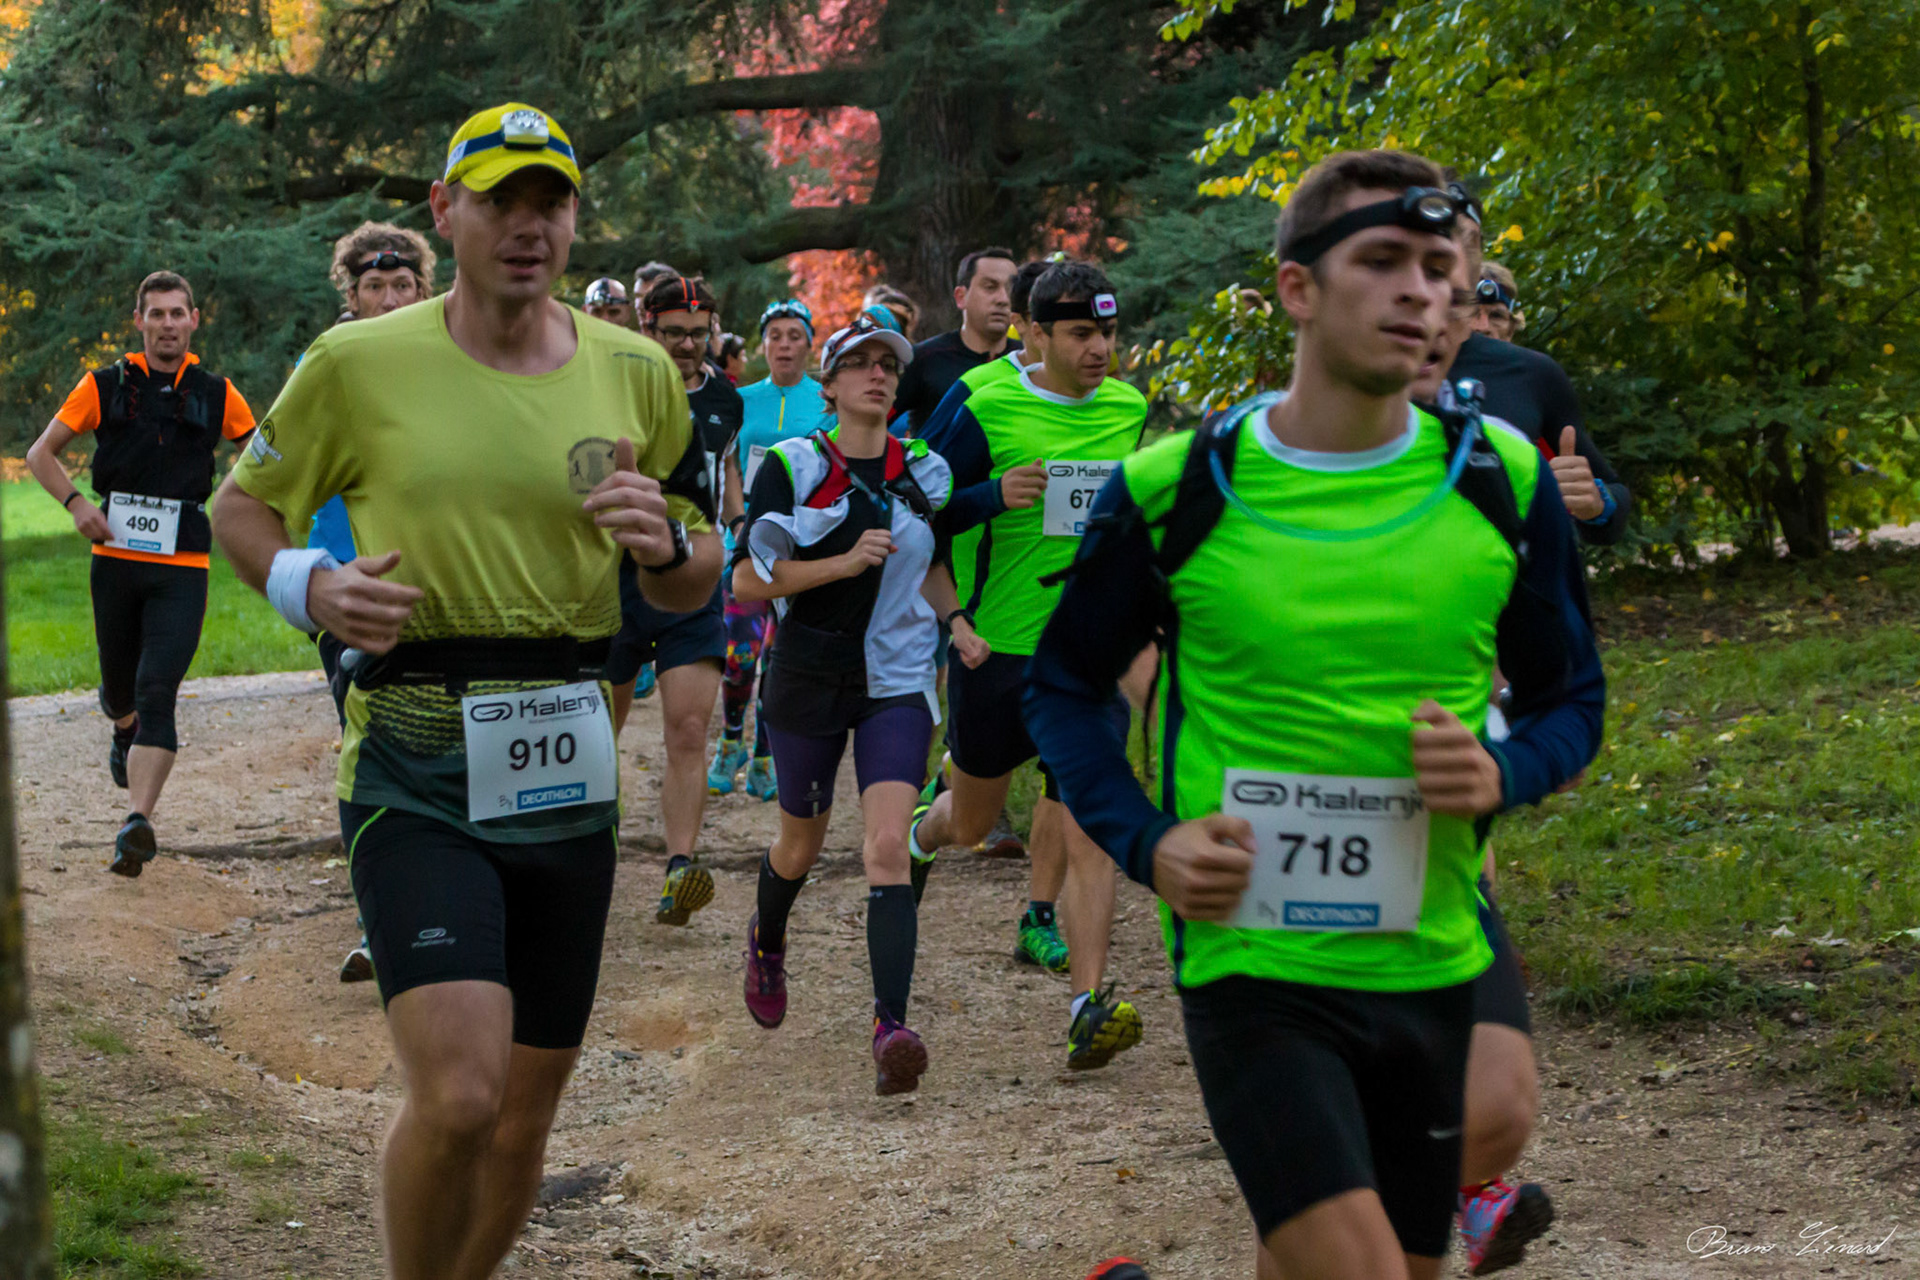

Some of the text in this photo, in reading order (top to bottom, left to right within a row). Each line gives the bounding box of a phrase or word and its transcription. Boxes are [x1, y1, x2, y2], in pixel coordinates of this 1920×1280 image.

[1077, 465, 1113, 477] Kale
[1070, 488, 1102, 510] 67
[126, 515, 159, 533] 490
[519, 695, 600, 718] Kalenji
[509, 732, 576, 771] 910
[521, 786, 583, 806] DECATHLON
[1278, 831, 1370, 877] 718
